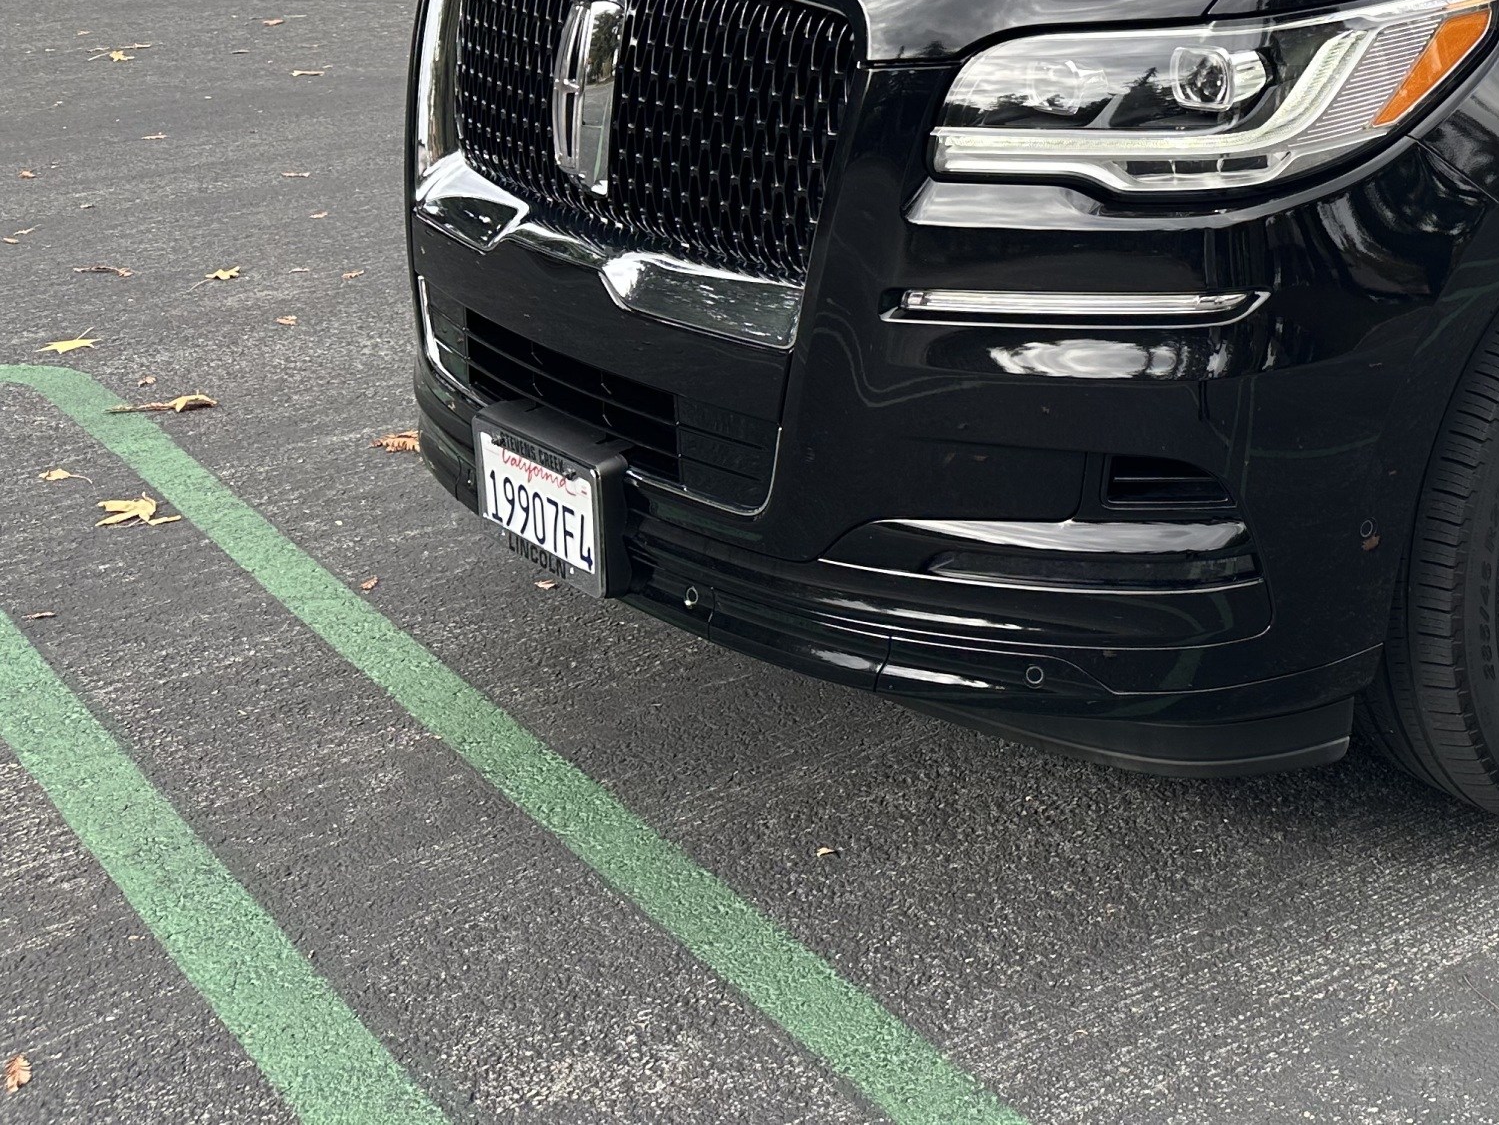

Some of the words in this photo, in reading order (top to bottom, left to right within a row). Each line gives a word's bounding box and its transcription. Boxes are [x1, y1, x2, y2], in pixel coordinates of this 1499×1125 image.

[500, 431, 537, 462] STEVENS
[538, 449, 565, 475] CREEK
[502, 446, 577, 497] California
[489, 469, 594, 571] 19907F4
[507, 531, 567, 579] LINCOLN
